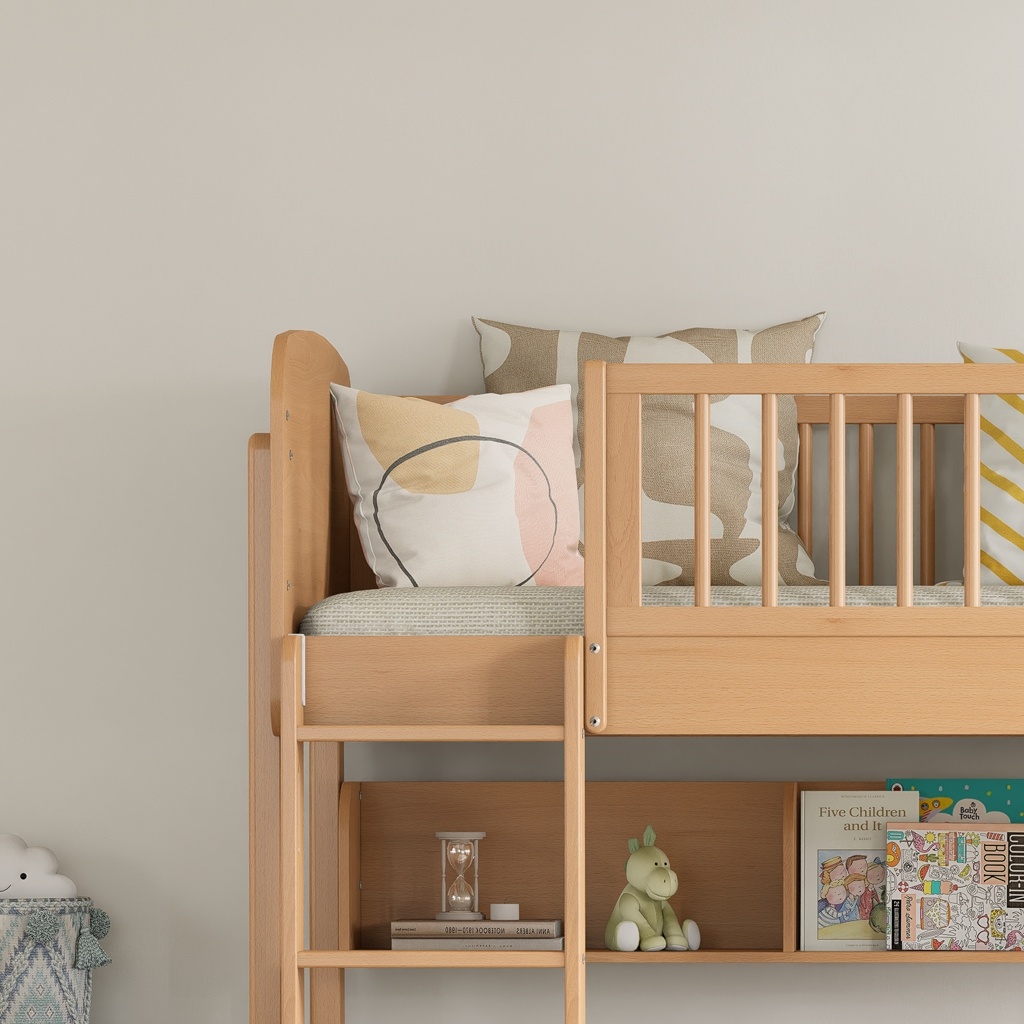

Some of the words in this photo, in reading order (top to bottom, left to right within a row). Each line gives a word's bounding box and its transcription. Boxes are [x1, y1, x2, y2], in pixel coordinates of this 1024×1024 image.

[818, 806, 847, 818] Five
[849, 806, 907, 818] Children
[960, 806, 978, 815] Baby
[959, 813, 980, 821] Touch
[843, 820, 869, 831] and
[872, 820, 882, 831] It
[983, 844, 1006, 883] BOOK
